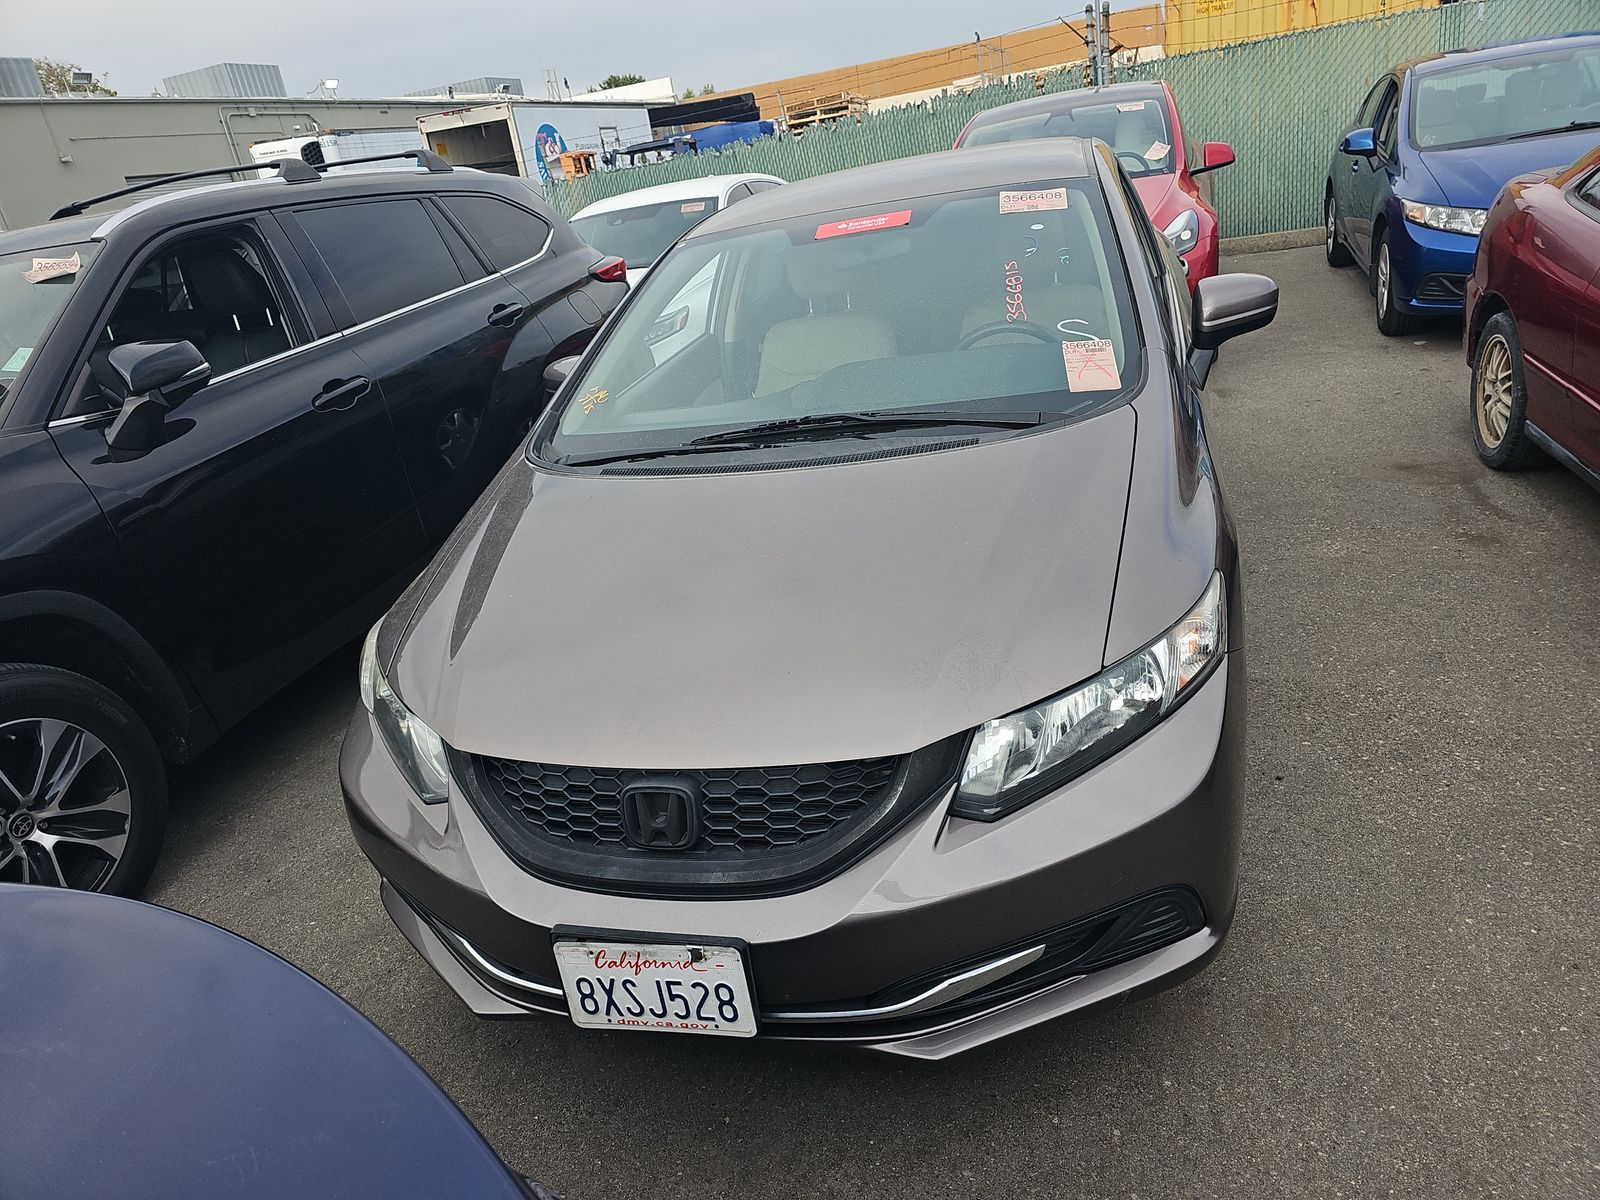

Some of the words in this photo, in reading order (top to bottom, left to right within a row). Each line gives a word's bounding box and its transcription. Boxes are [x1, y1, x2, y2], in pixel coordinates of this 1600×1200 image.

[1003, 191, 1063, 203] 3566408
[1062, 340, 1112, 351] 3566408
[594, 949, 708, 976] California
[575, 977, 739, 1023] 8XSJ528
[617, 1018, 709, 1030] dmv.ca.gov
